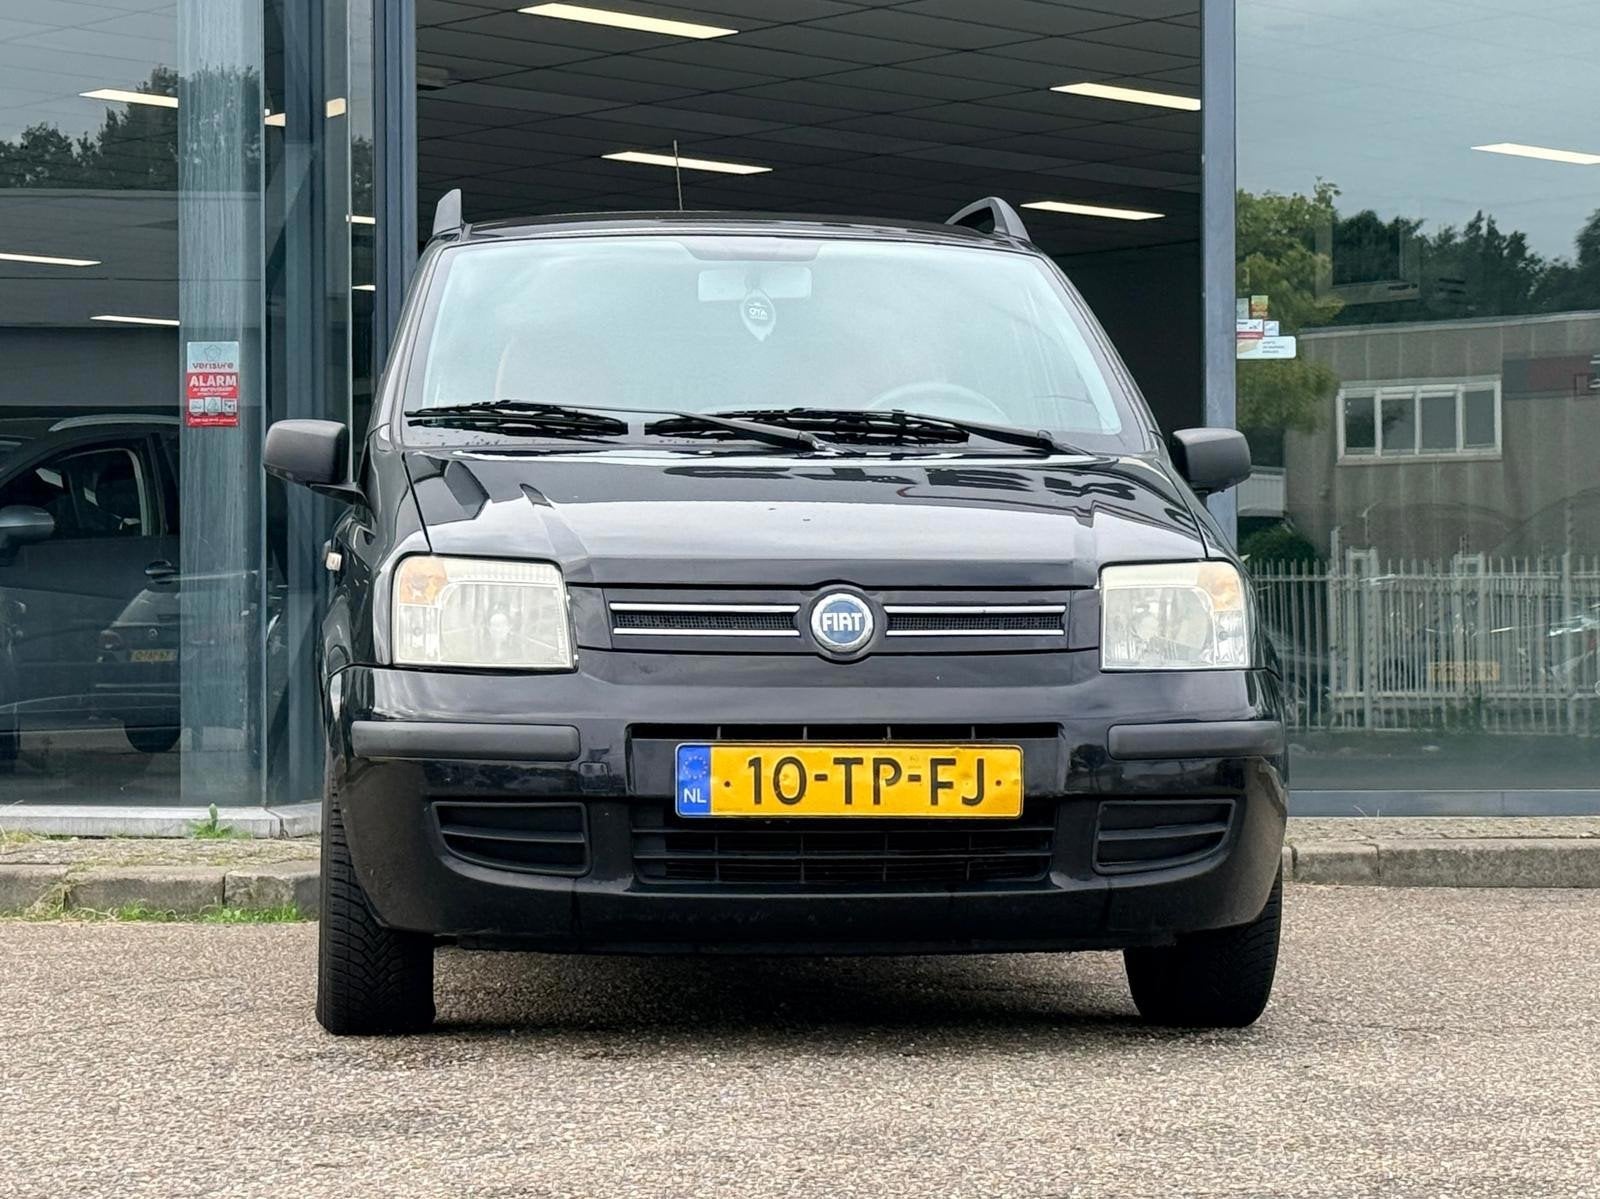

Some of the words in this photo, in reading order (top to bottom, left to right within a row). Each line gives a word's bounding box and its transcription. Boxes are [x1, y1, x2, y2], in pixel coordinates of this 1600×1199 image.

[190, 375, 237, 387] ALARM
[822, 612, 862, 632] FIAT
[748, 756, 985, 806] 10-TP-FJ
[683, 788, 706, 803] NL
